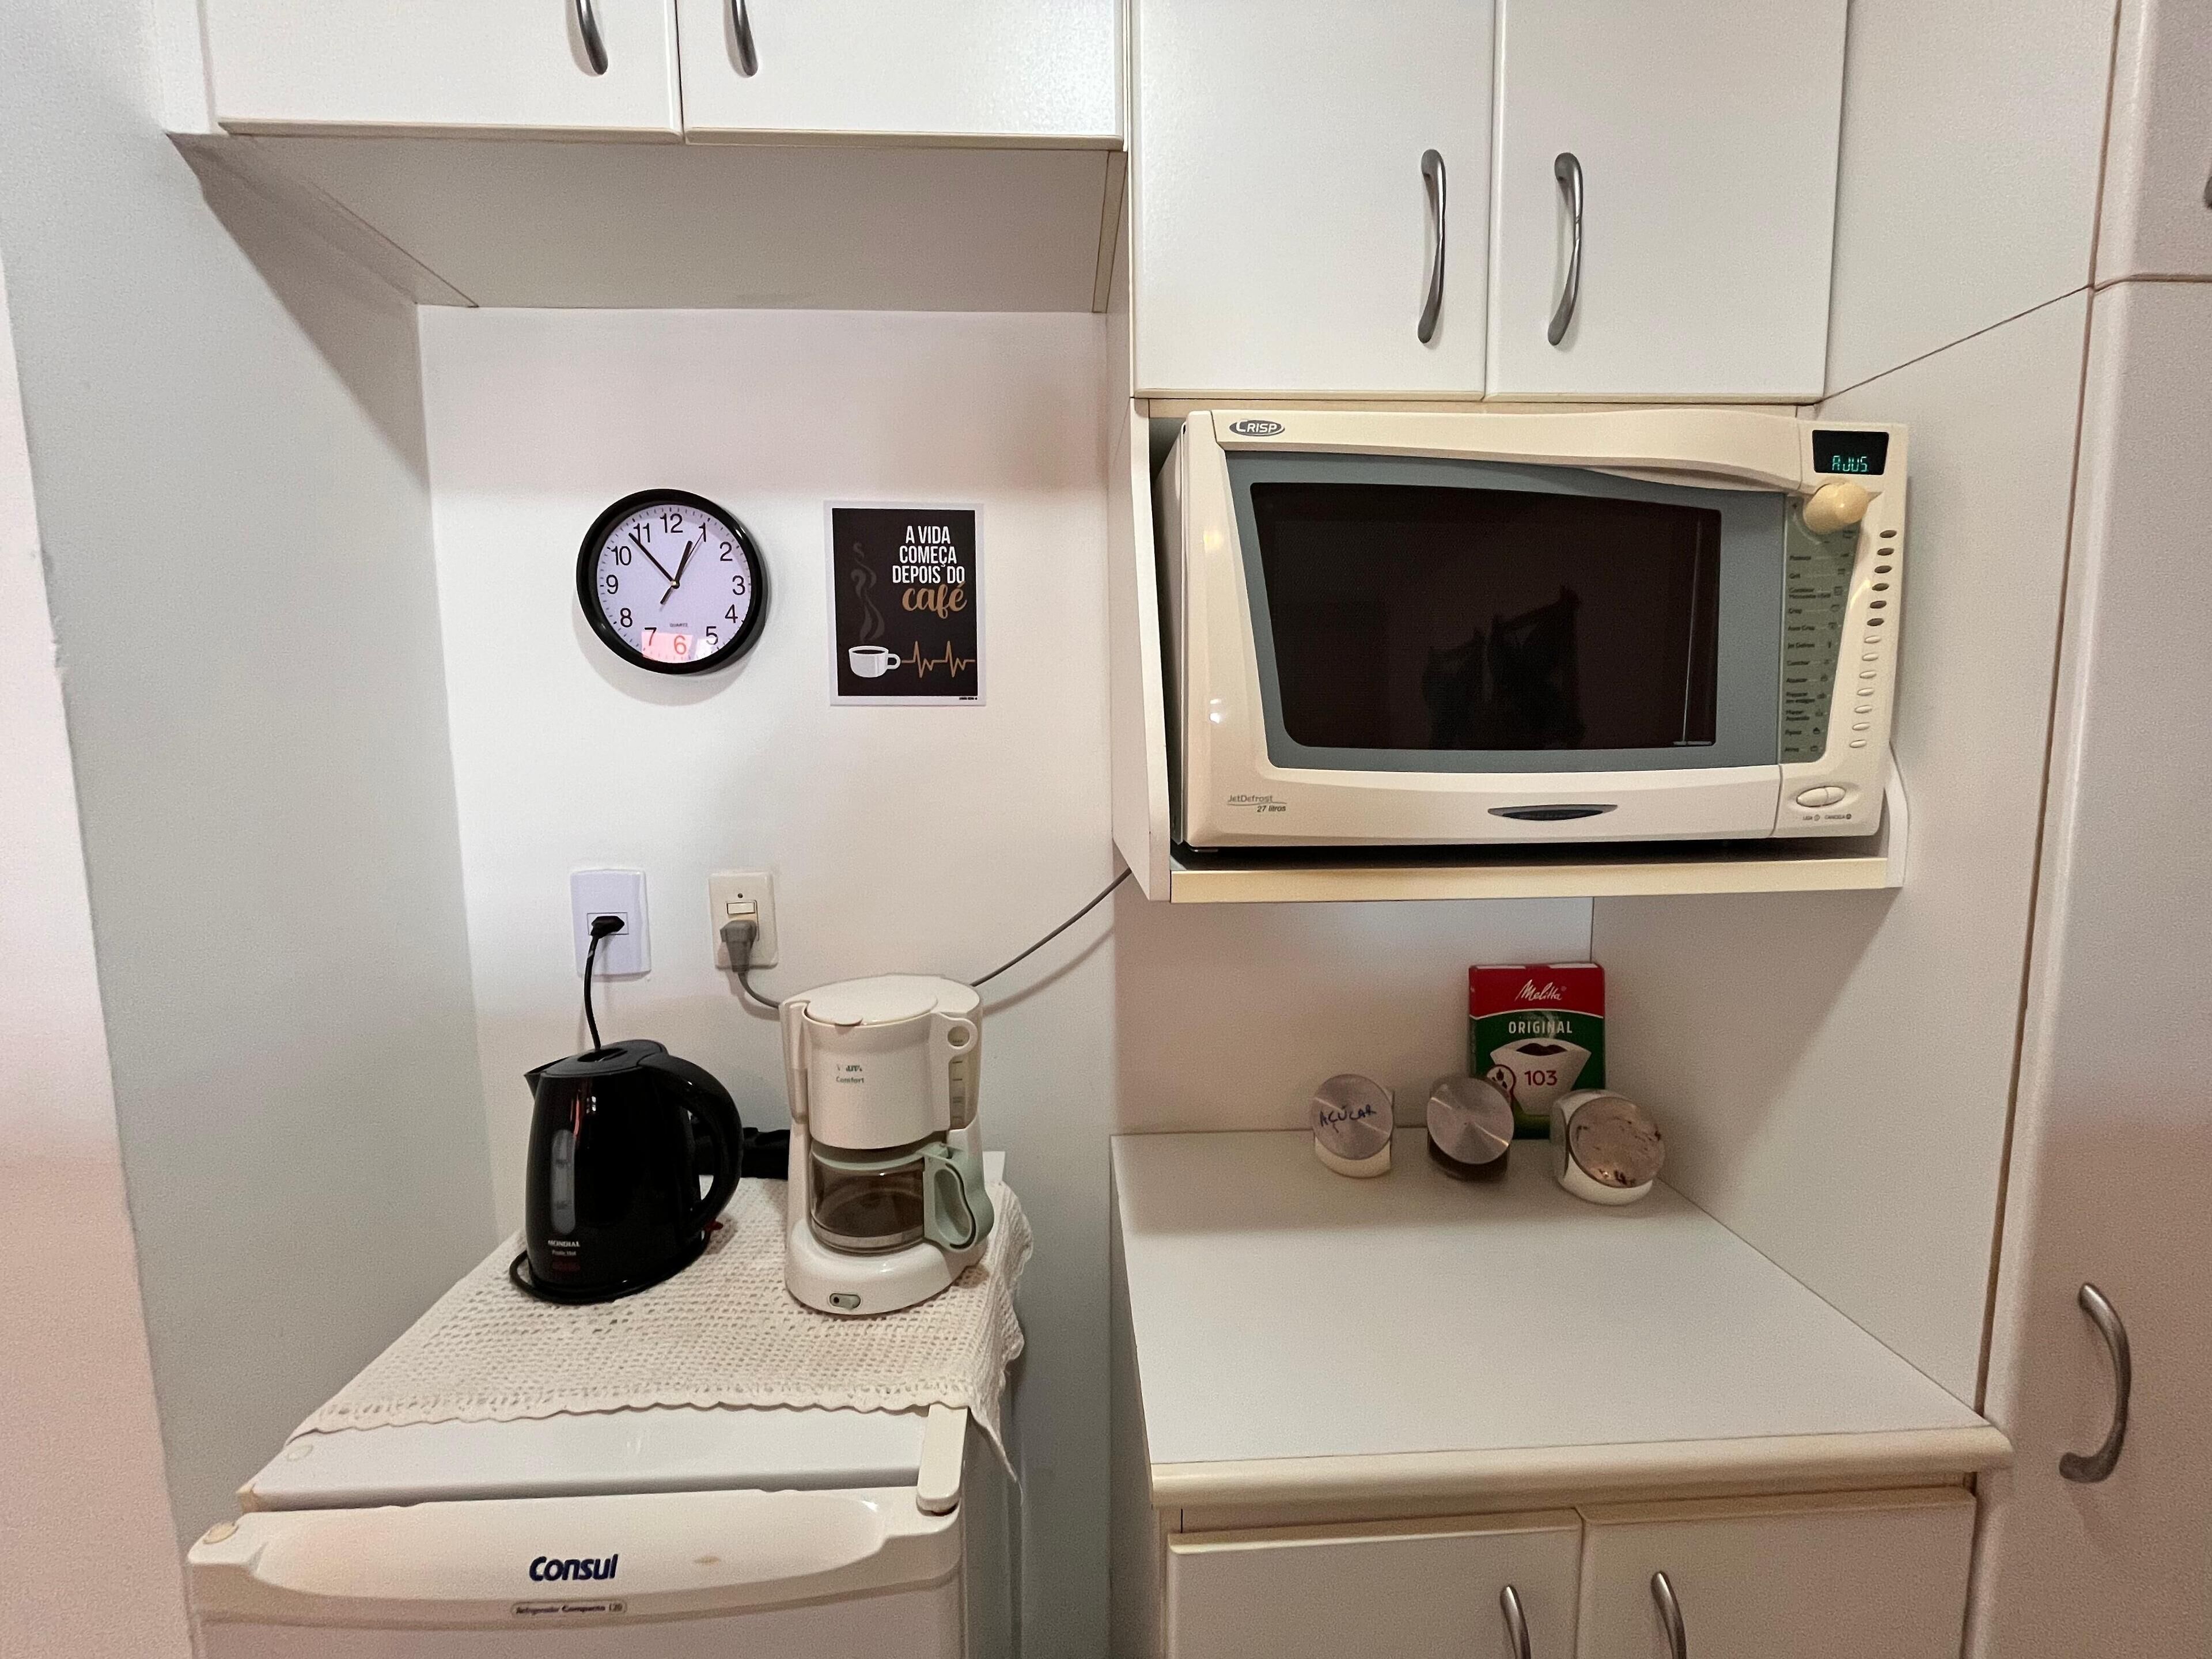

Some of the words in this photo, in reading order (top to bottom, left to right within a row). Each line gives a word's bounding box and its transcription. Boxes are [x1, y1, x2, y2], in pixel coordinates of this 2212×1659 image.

[1236, 419, 1277, 433] CRISP
[660, 513, 683, 533] 12
[699, 522, 707, 542] 1
[634, 523, 650, 543] 11
[906, 525, 915, 544] A
[918, 525, 950, 544] VIDA
[611, 546, 632, 566] 10
[719, 541, 733, 561] 2
[899, 546, 957, 567] COMEÇA
[606, 574, 619, 594] 9
[892, 565, 941, 584] DEPOIS
[947, 566, 965, 584] DO
[732, 575, 745, 595] 3
[902, 581, 967, 619] café
[620, 608, 633, 627] 8
[725, 604, 738, 623] 4
[644, 627, 657, 646] 7
[674, 635, 687, 654] 6
[706, 626, 719, 645] 5
[1228, 794, 1273, 802] JetDefrost
[1514, 979, 1563, 1001] Melitta
[1508, 1021, 1573, 1034] ORIGINAL
[1524, 1070, 1558, 1086] 103
[529, 1554, 619, 1581] Consul
